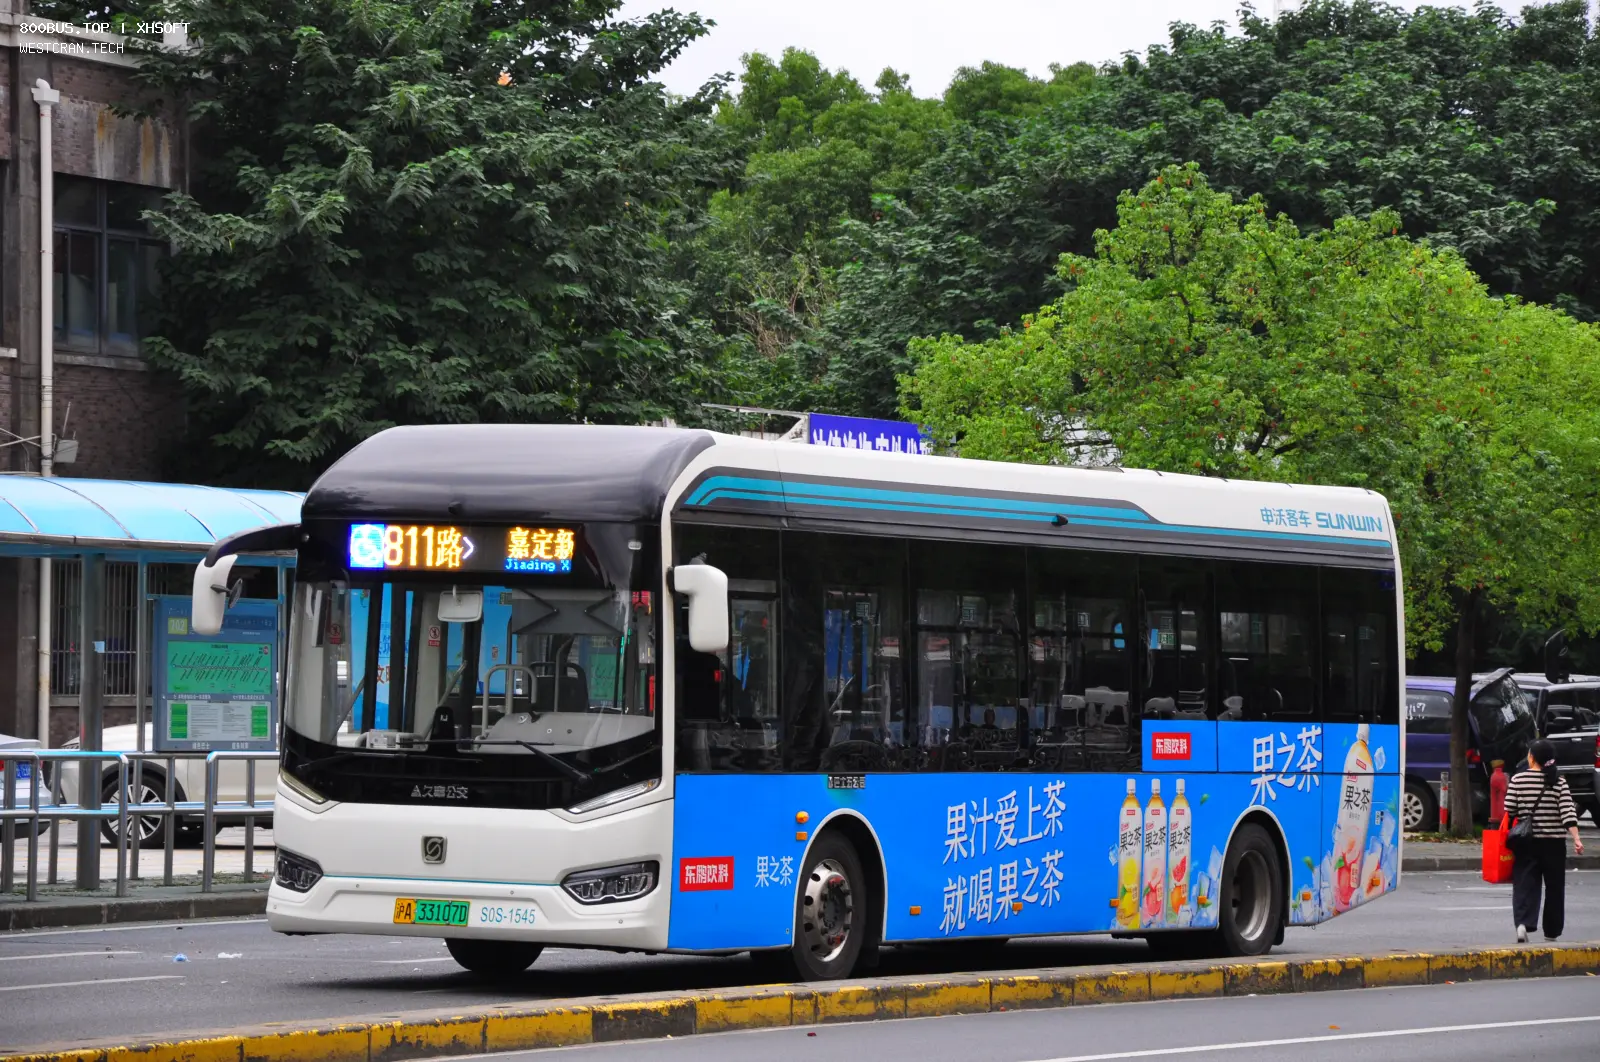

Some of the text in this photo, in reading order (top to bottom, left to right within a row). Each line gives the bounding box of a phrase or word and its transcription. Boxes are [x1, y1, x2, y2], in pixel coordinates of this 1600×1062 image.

[1260, 507, 1383, 533] 申沃客车 SUNWIN
[384, 525, 574, 568] 811路 嘉定新
[505, 558, 570, 571] Jiading X
[1155, 738, 1188, 755] 东鹏饮料
[1249, 724, 1323, 807] 果之茶
[1342, 784, 1371, 812] 果之茶
[942, 779, 1067, 865] 果汁爱上茶
[1119, 826, 1142, 854] 果之茶
[1144, 825, 1166, 853] 果之茶
[1169, 825, 1191, 853] 果之茶
[684, 863, 729, 885] 东鹏饮料
[754, 855, 794, 888] 果之茶
[939, 849, 1064, 936] 就喝果之茶
[418, 903, 468, 923] 33107D
